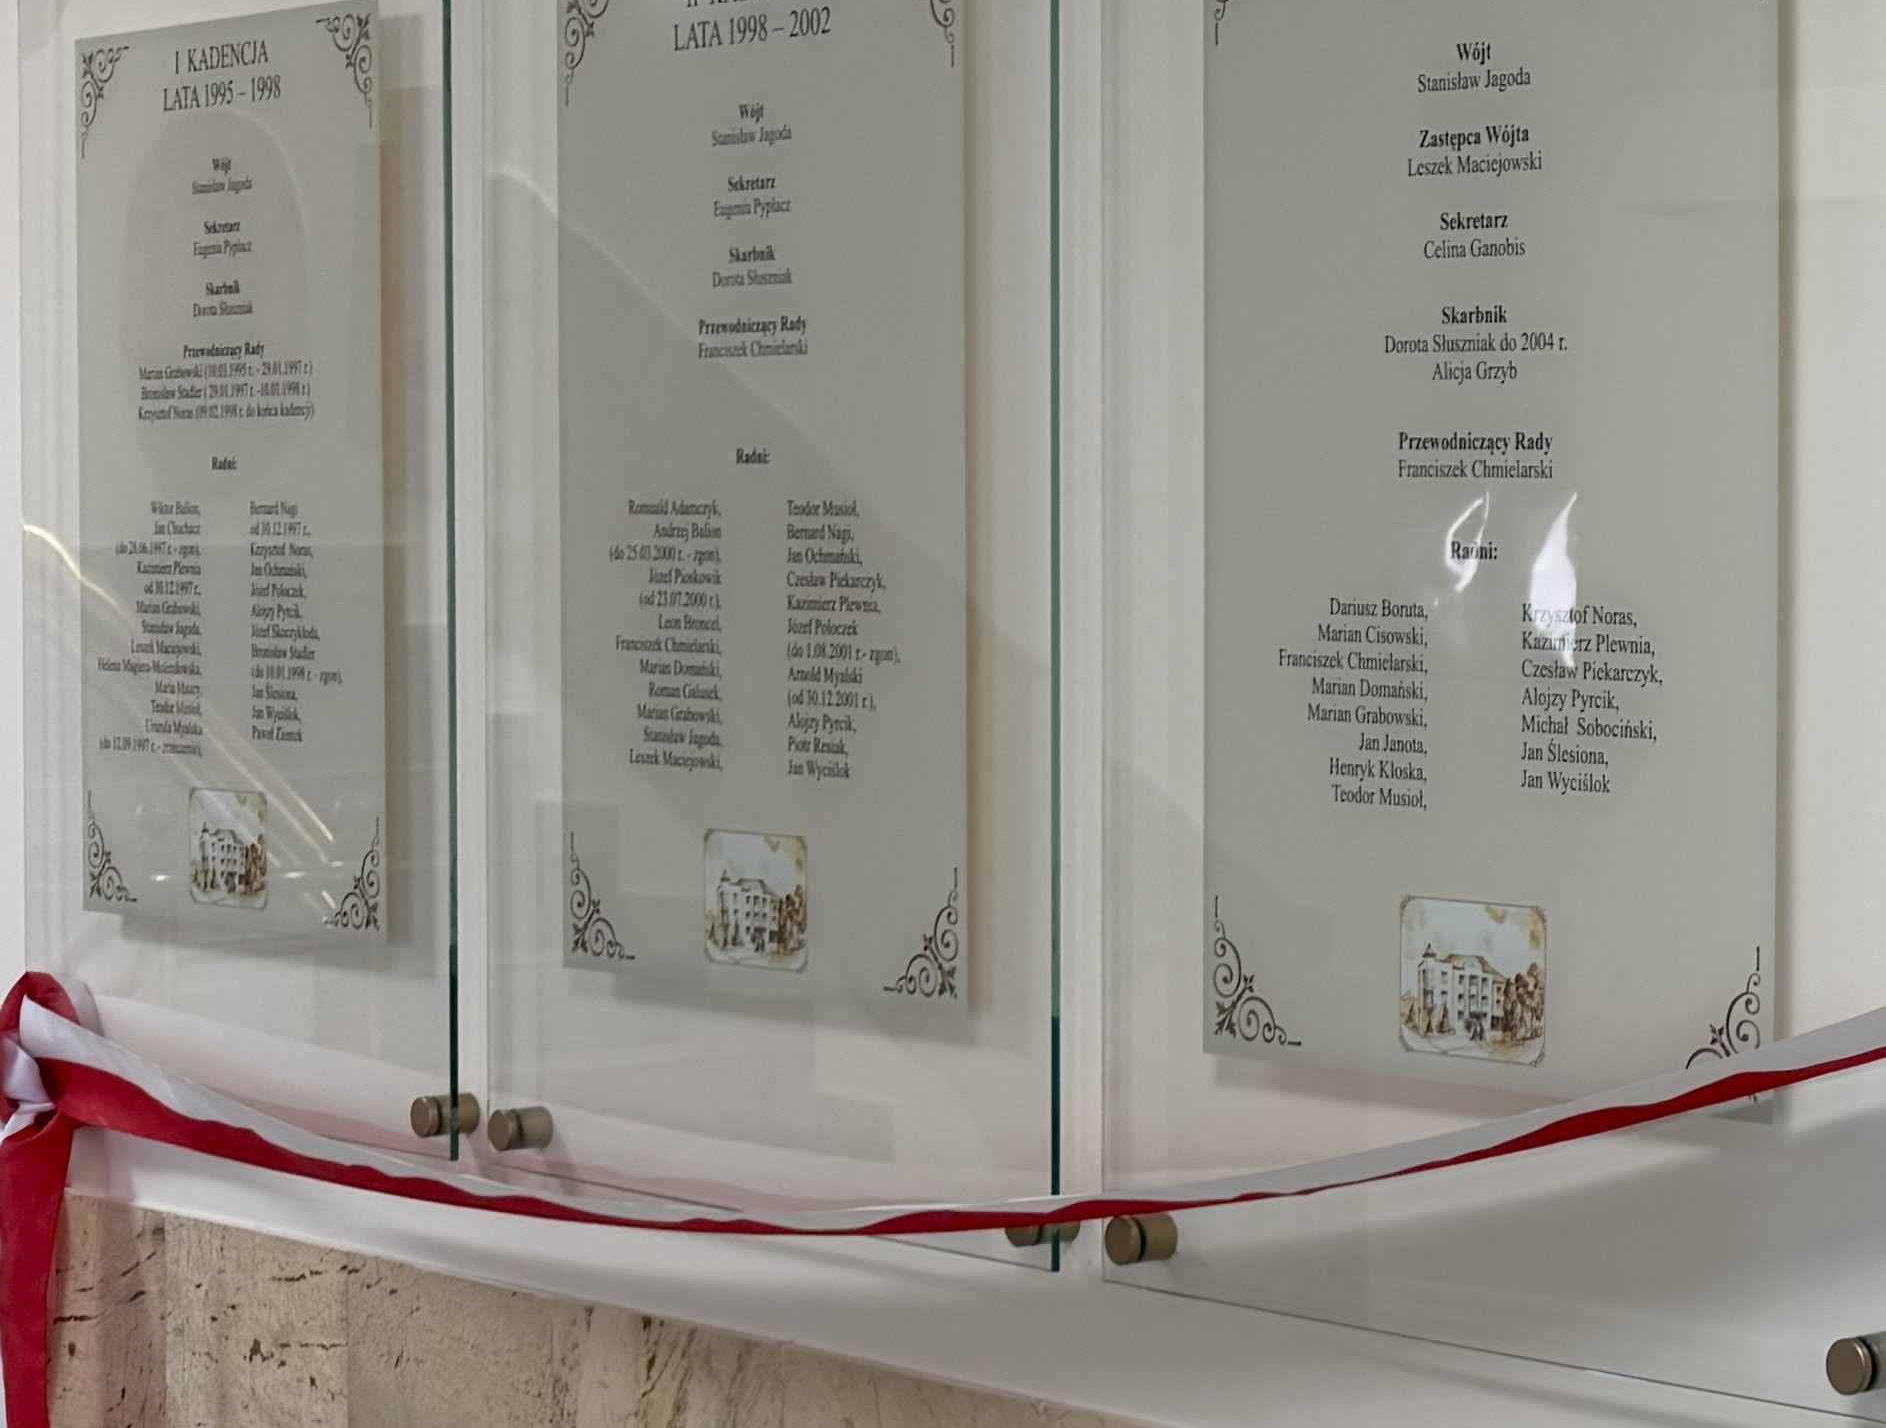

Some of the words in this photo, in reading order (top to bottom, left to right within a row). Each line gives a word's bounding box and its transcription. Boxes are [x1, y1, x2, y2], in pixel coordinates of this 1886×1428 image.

[674, 20, 723, 51] LATA
[729, 13, 768, 45] 1998
[789, 6, 831, 38] 2002
[175, 50, 179, 75] I
[188, 40, 269, 73] KADENCJA
[1456, 41, 1491, 65] Wójt
[1418, 71, 1481, 93] Stanisław
[1484, 66, 1531, 92] Jagoda
[163, 85, 201, 112] LATA
[205, 80, 234, 108] 1995
[251, 74, 281, 102] 1998
[1419, 130, 1481, 152] Zastępca
[1485, 124, 1529, 148] Wójta
[1408, 155, 1453, 177] Leszek
[1457, 150, 1542, 177] Maciejowski
[1440, 212, 1508, 230] Sekretarz
[1424, 239, 1467, 259] Celina
[1470, 236, 1526, 257] Ganobis
[1441, 305, 1507, 324] Skarbnik
[1385, 335, 1428, 354] Dorota
[1432, 332, 1496, 353] Słuszniak
[1499, 332, 1517, 352] do
[1520, 332, 1555, 351] 2004
[1558, 337, 1567, 351] r.
[1432, 361, 1472, 386] Alicja
[1476, 360, 1518, 385] Grzyb
[1399, 432, 1510, 456] Przewodniczący
[1515, 431, 1553, 456] Rady
[1398, 459, 1467, 478] Franciszek
[1471, 459, 1553, 479] Chmielarski
[1330, 597, 1378, 617] Dariusz
[1381, 599, 1428, 621] Boruta,
[1318, 623, 1362, 643] Marian
[1365, 625, 1428, 648] Cisowski,
[1279, 648, 1344, 669] Franciszek
[1347, 651, 1428, 675] Chmielarski,
[1312, 676, 1356, 697] Marian
[1359, 678, 1428, 702] Domański,
[1522, 714, 1568, 735] Michał
[1577, 717, 1657, 743] Sobociński,
[1521, 741, 1543, 761] Jan
[1547, 740, 1609, 769] Ślesiona,
[1521, 769, 1543, 789] Jan
[1547, 771, 1610, 795] Wyciślok
